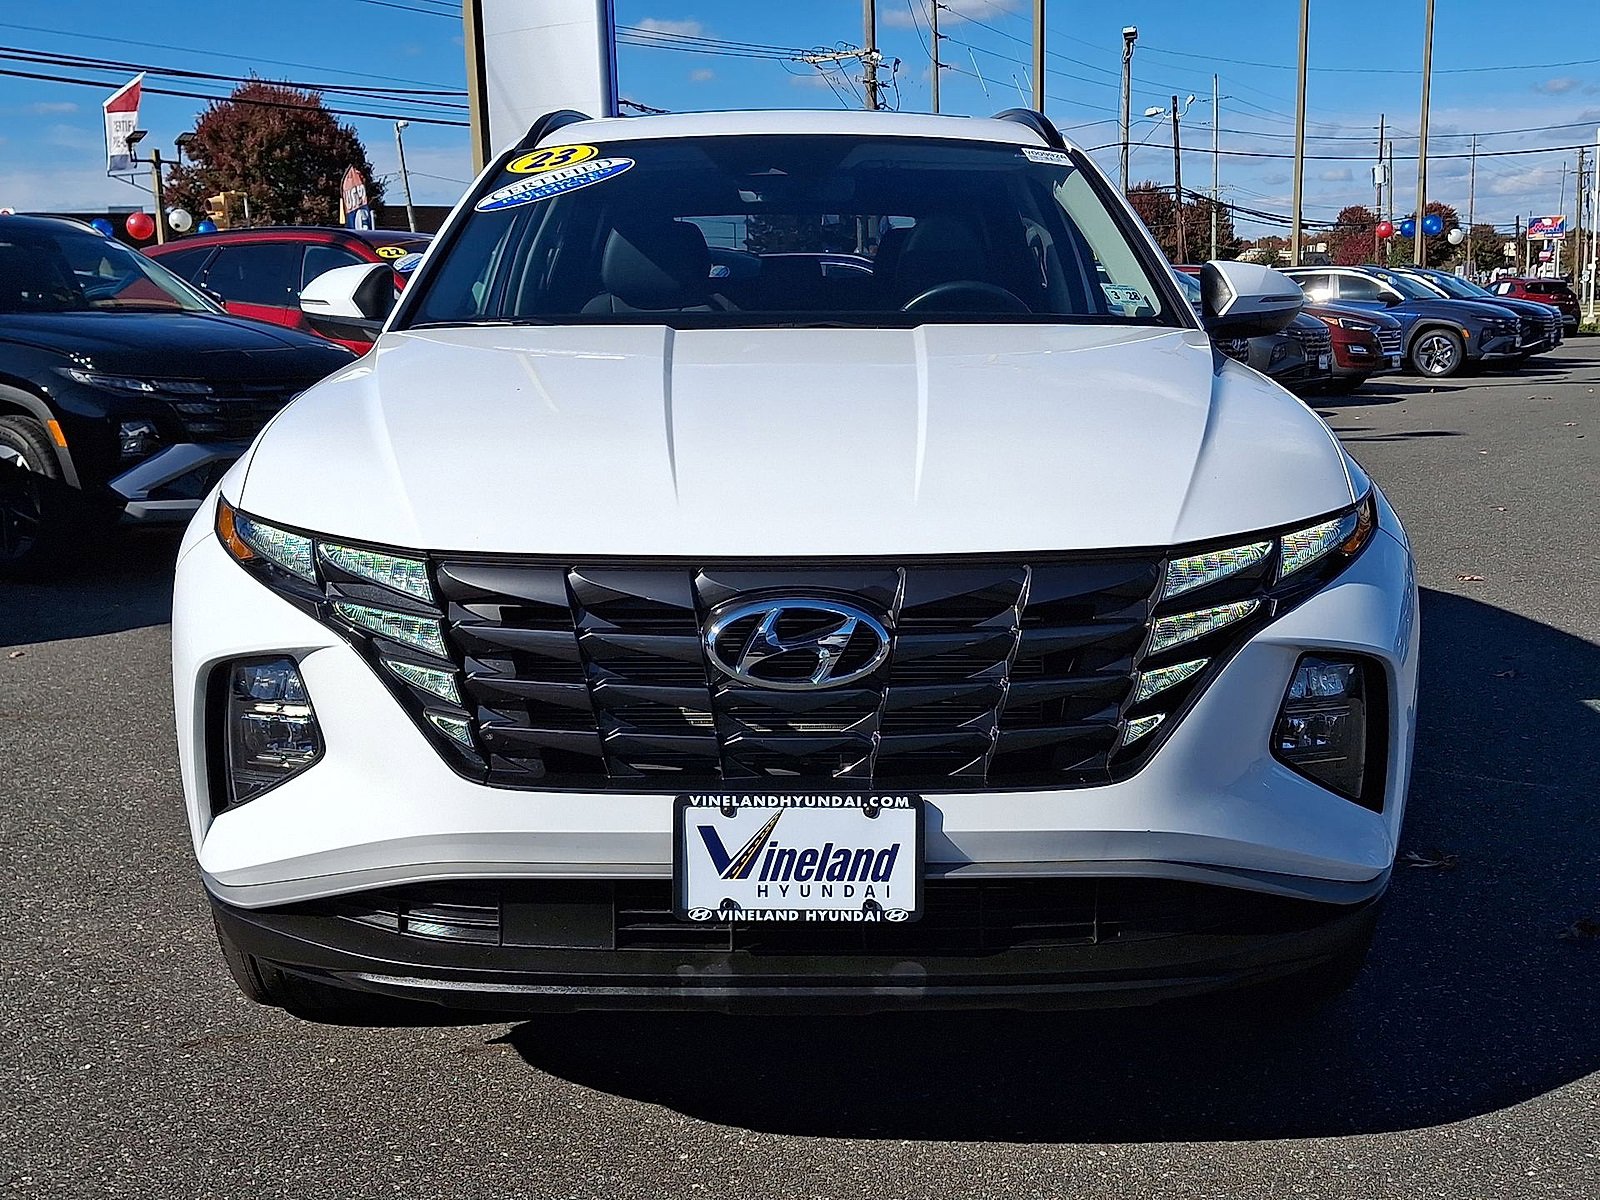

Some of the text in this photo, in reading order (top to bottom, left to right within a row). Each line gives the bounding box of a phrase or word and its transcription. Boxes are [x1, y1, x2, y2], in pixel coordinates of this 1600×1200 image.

[524, 148, 578, 169] 23
[491, 159, 613, 201] CERTIFIED
[381, 248, 404, 257] 22
[1111, 291, 1140, 300] 3 28
[689, 795, 910, 808] VINELANDHYUNDAI.COM
[696, 808, 900, 882] Vineland
[757, 885, 891, 898] HYUNDAI
[717, 909, 881, 922] VINELAND HYUNDAI
